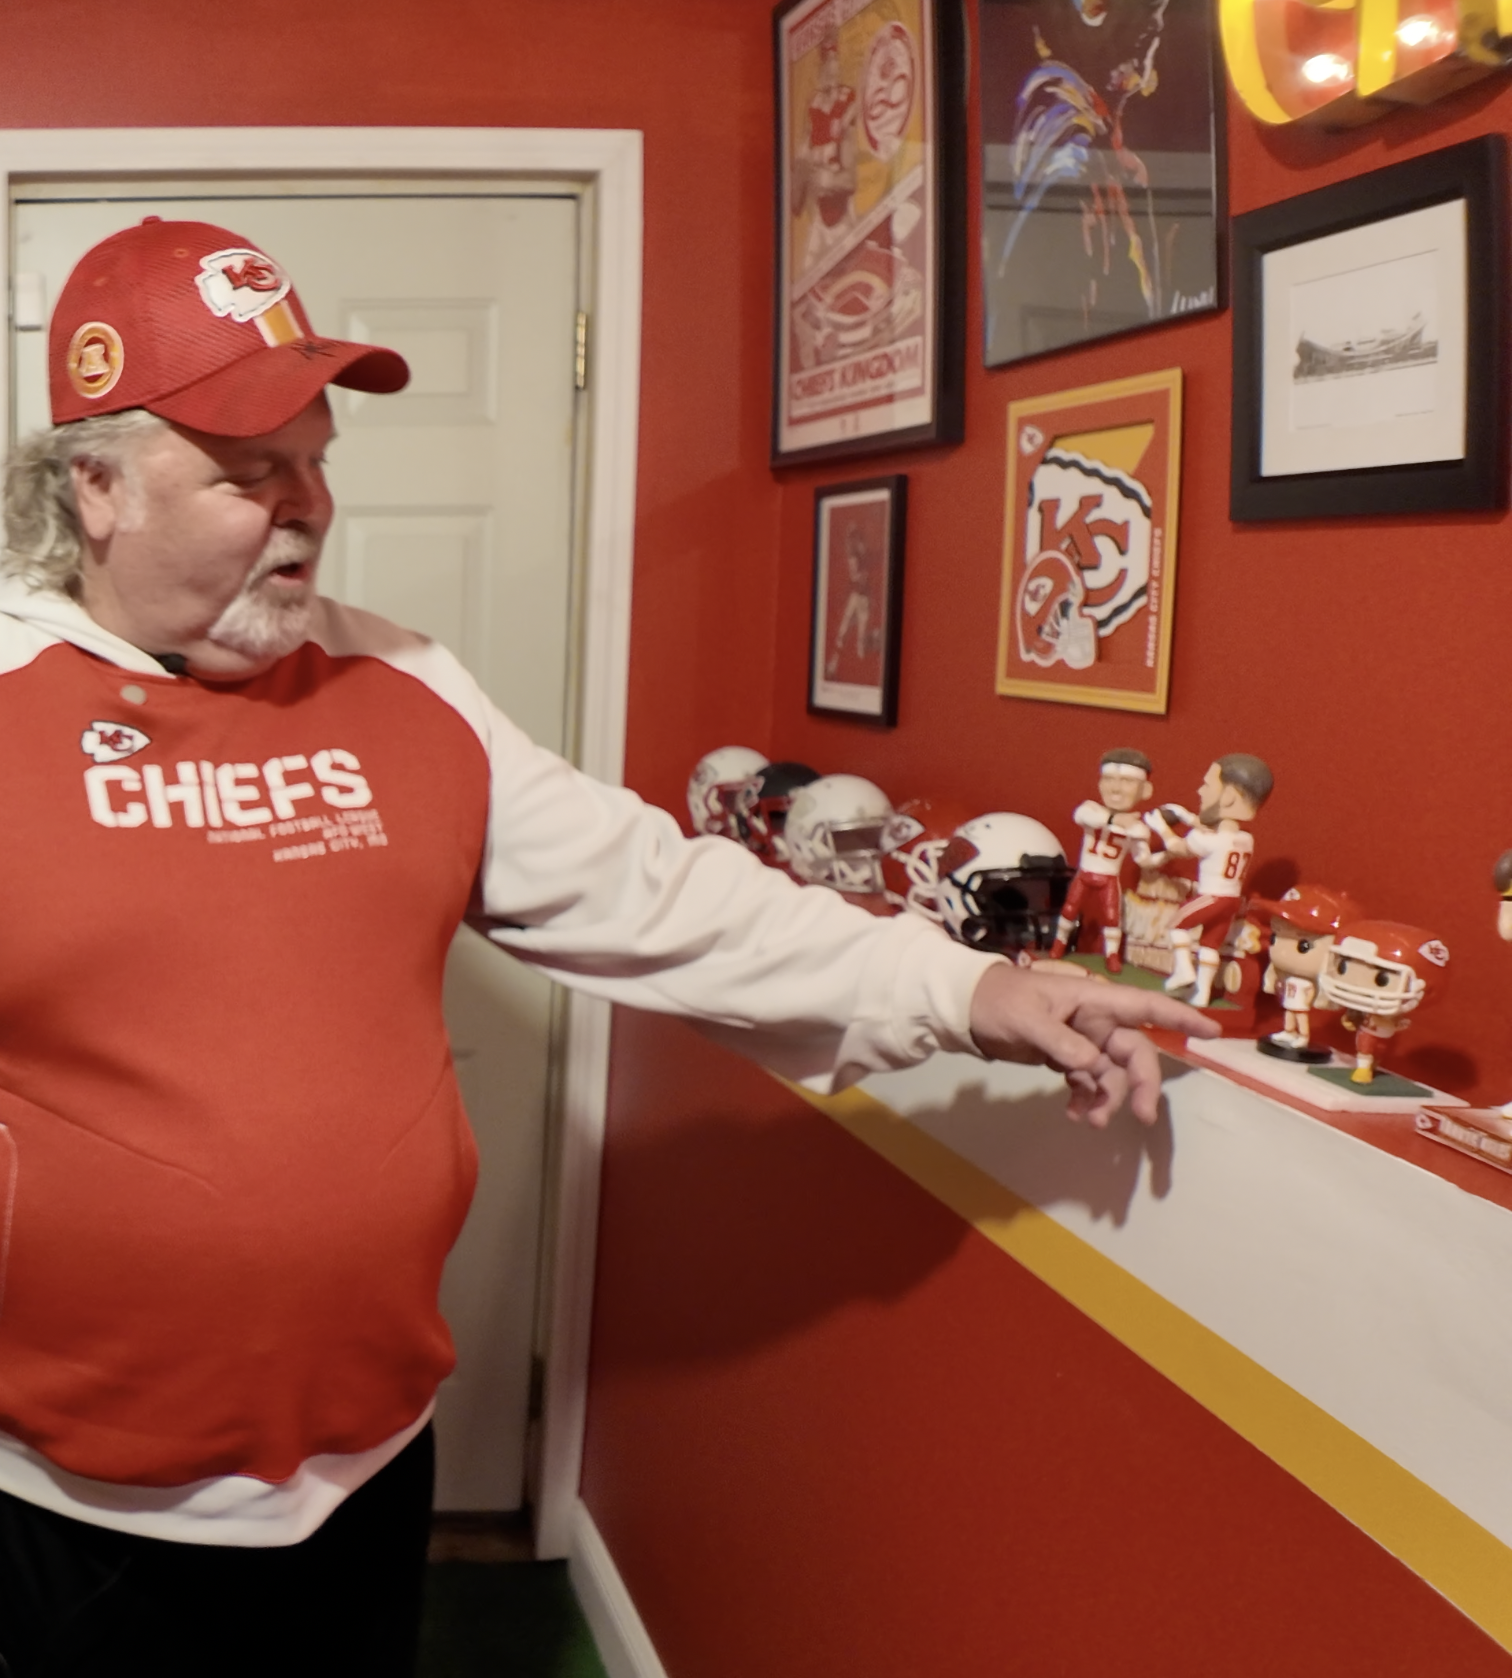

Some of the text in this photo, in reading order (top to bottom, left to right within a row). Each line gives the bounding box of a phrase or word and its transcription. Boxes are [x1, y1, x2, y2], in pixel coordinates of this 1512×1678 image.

[83, 748, 373, 828] CHIEFS
[268, 814, 334, 838] FOOTBALL
[1087, 827, 1128, 861] 15
[1224, 851, 1252, 881] 87
